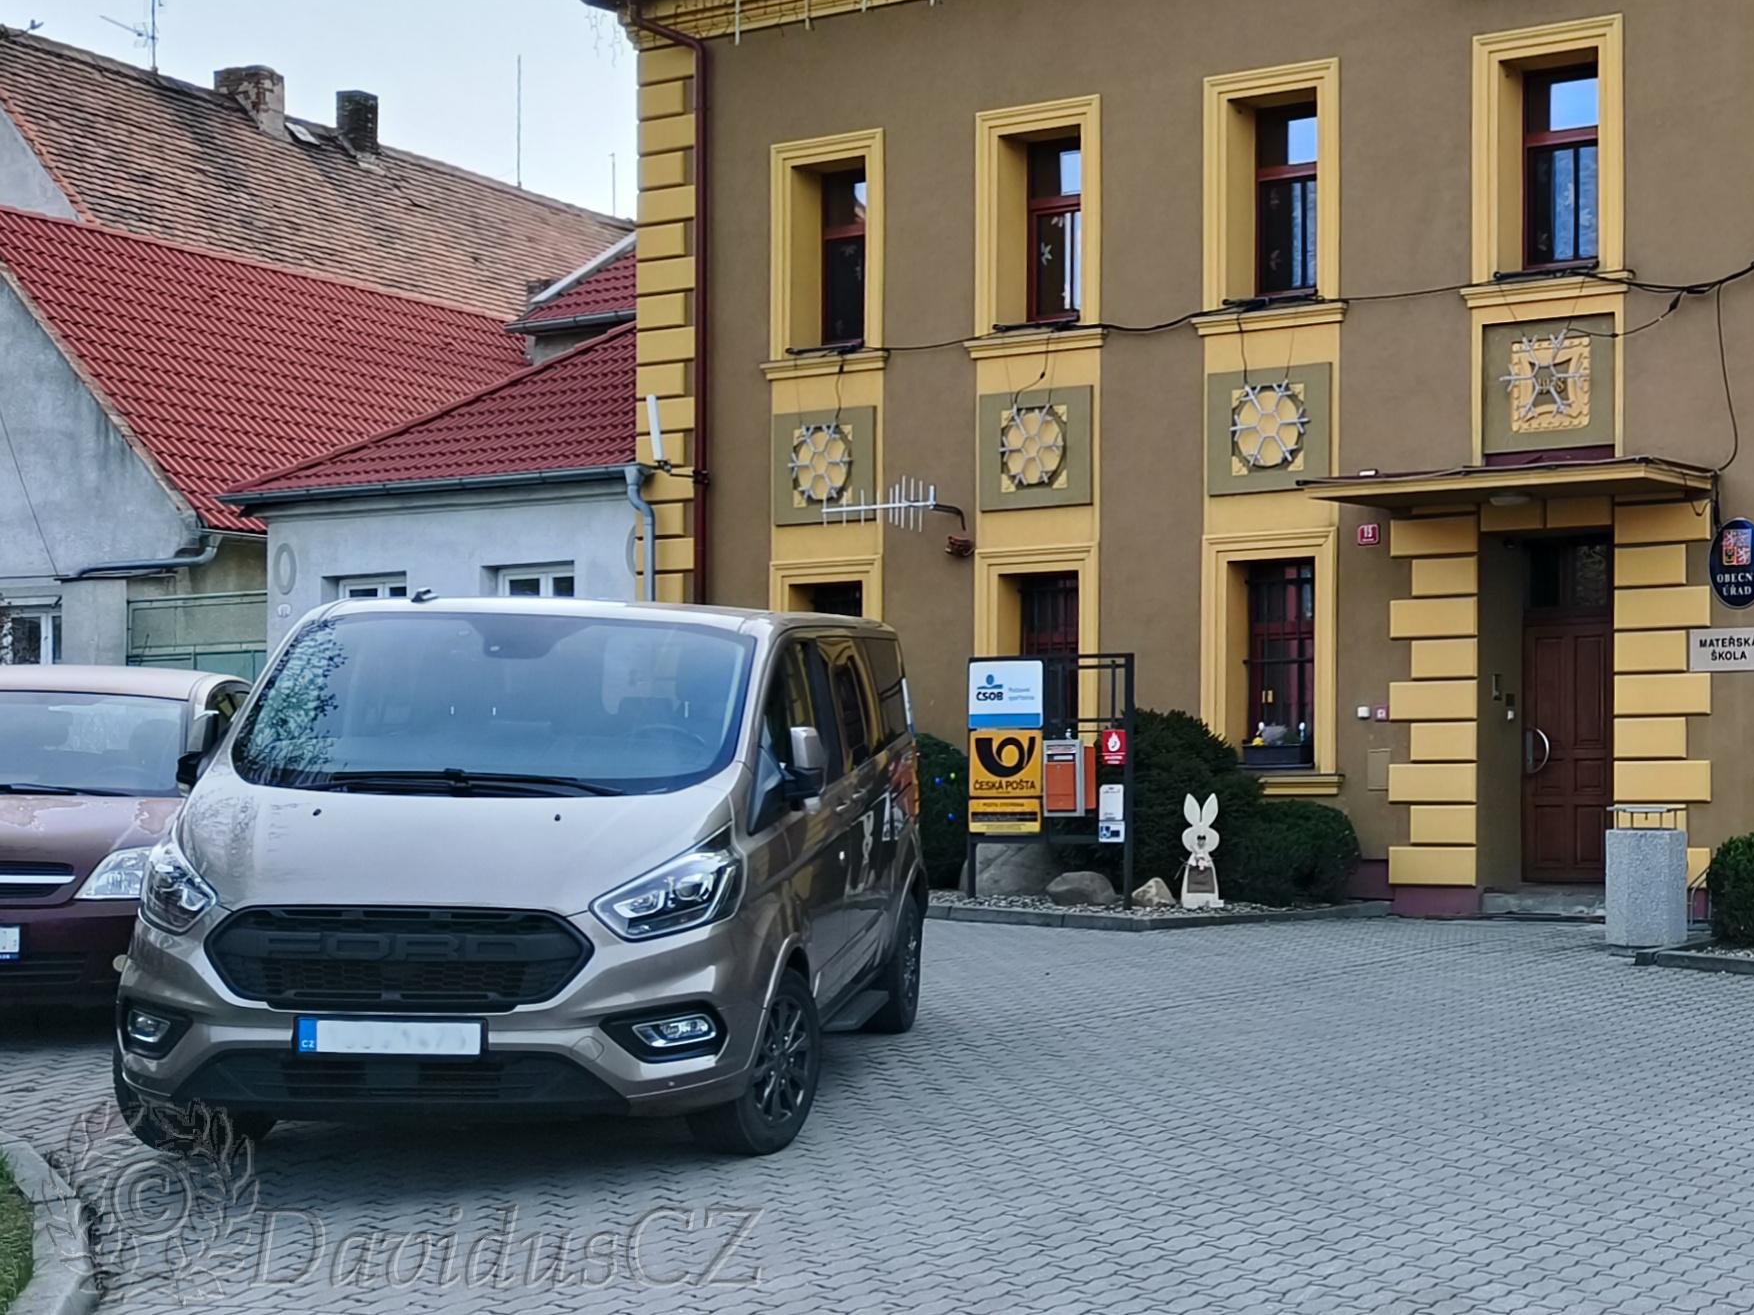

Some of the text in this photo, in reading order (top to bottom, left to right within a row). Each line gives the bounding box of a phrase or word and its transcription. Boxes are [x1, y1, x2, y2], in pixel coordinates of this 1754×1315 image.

[1722, 584, 1752, 596] ÚŘAD
[1711, 649, 1748, 661] ŠKOLA
[973, 778, 1036, 791] ČESKÁ POŠTA
[258, 933, 528, 962] FORD
